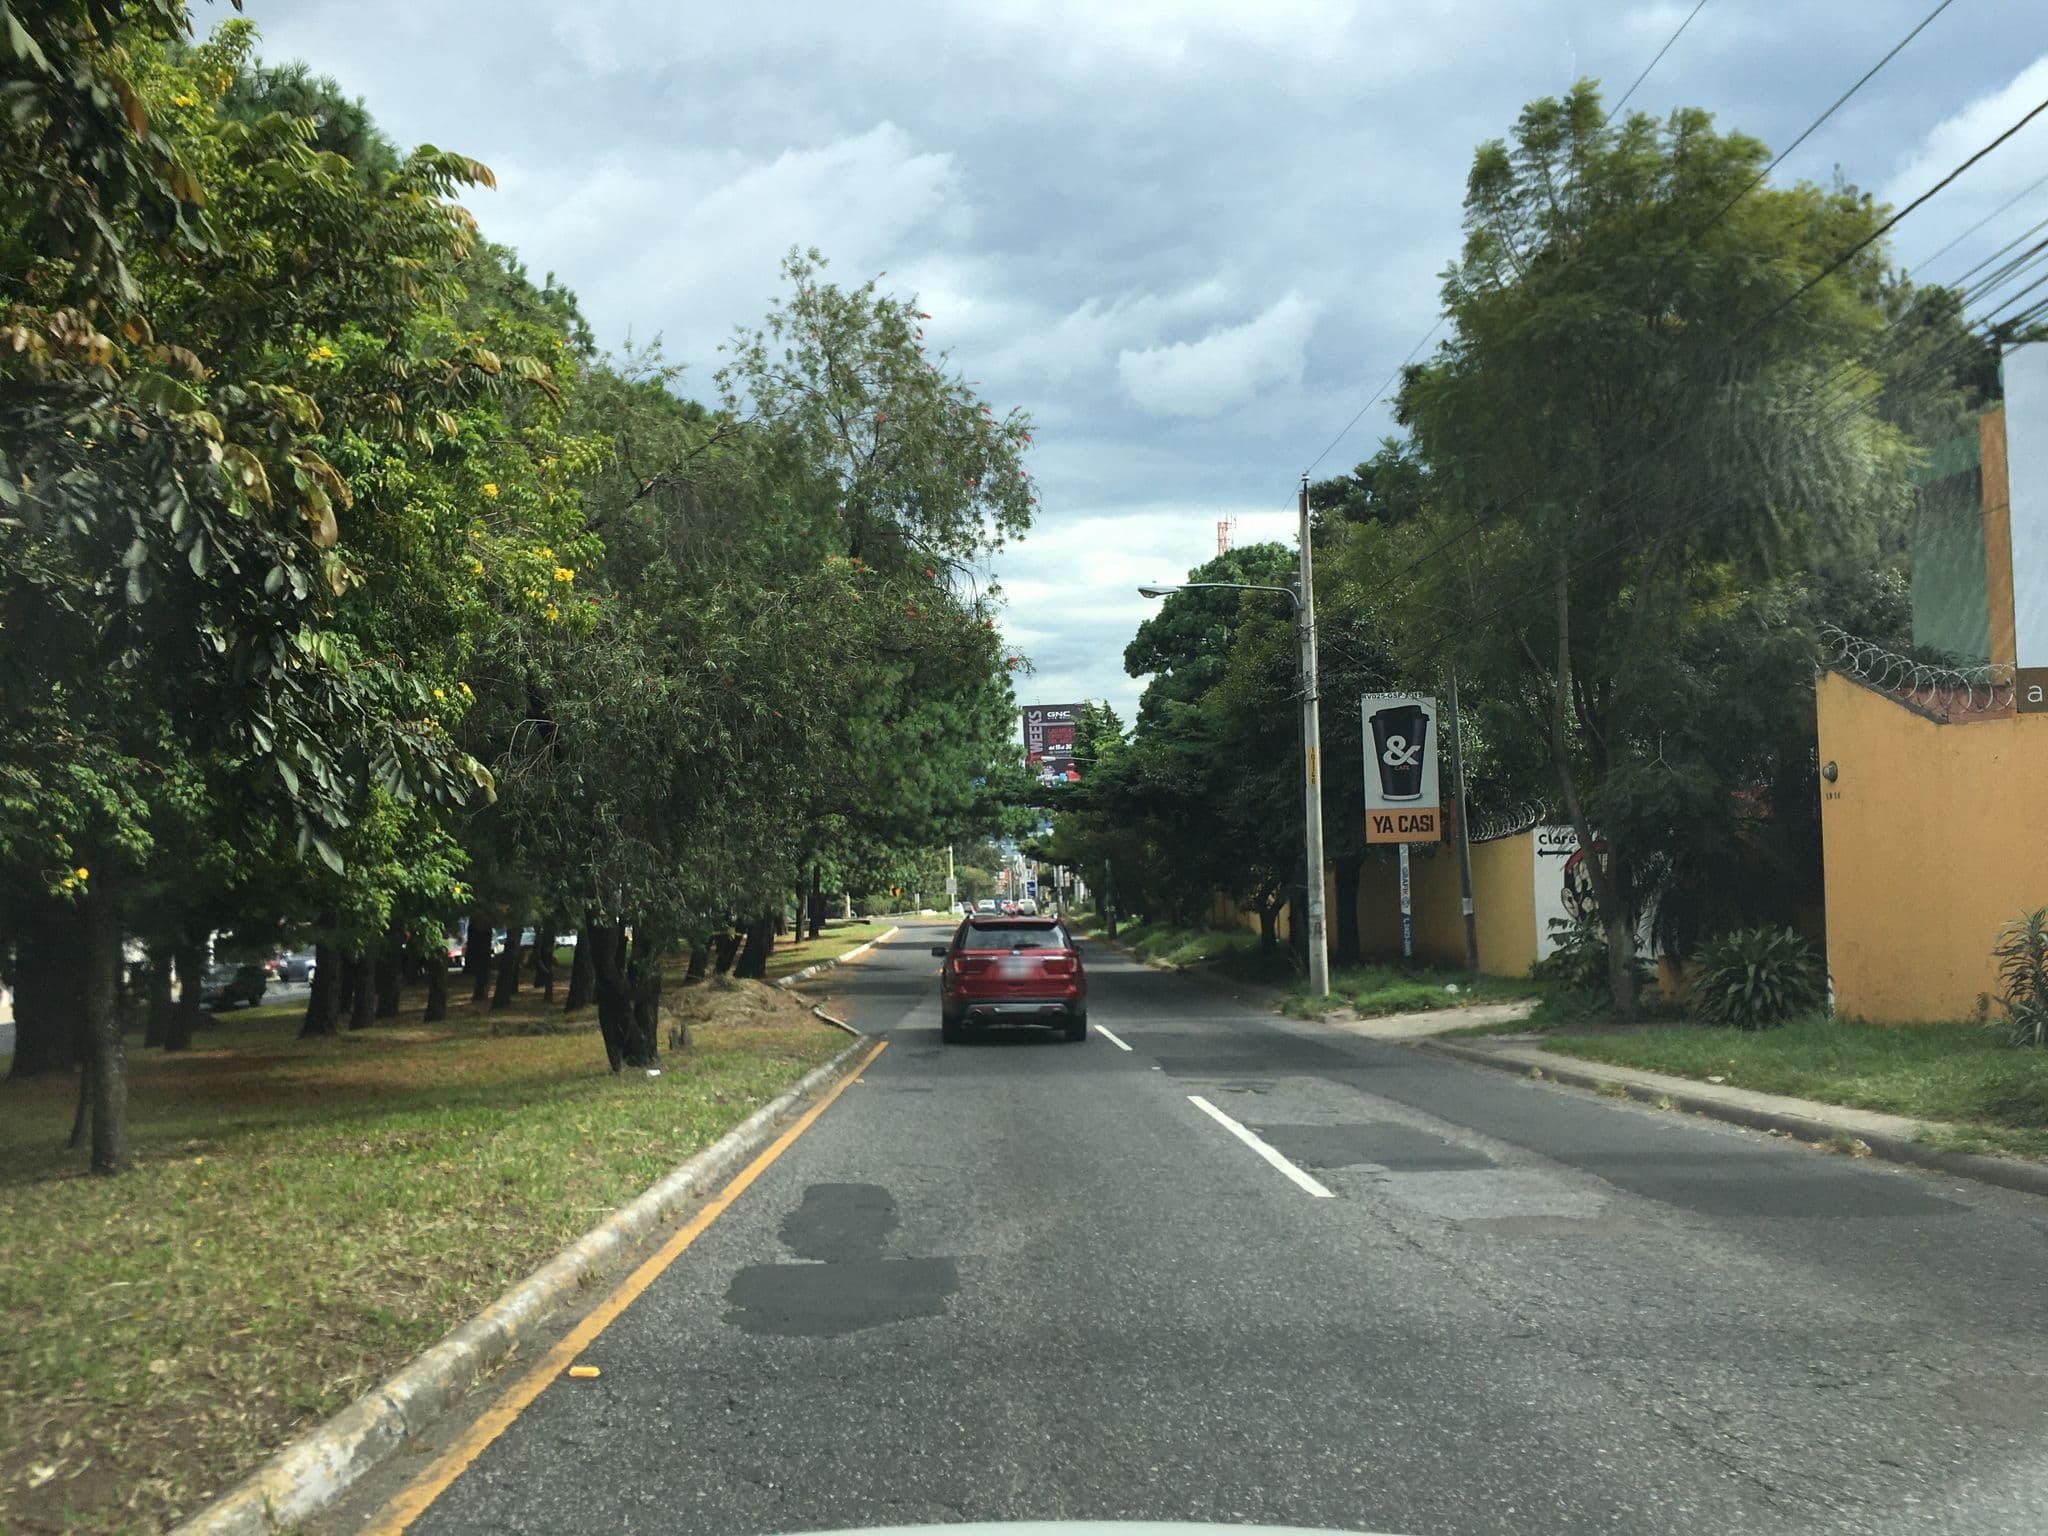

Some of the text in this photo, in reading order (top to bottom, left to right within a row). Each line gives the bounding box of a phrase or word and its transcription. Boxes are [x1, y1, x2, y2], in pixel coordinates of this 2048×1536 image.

[1383, 735, 1421, 765] &
[1373, 814, 1434, 834] YA CASI
